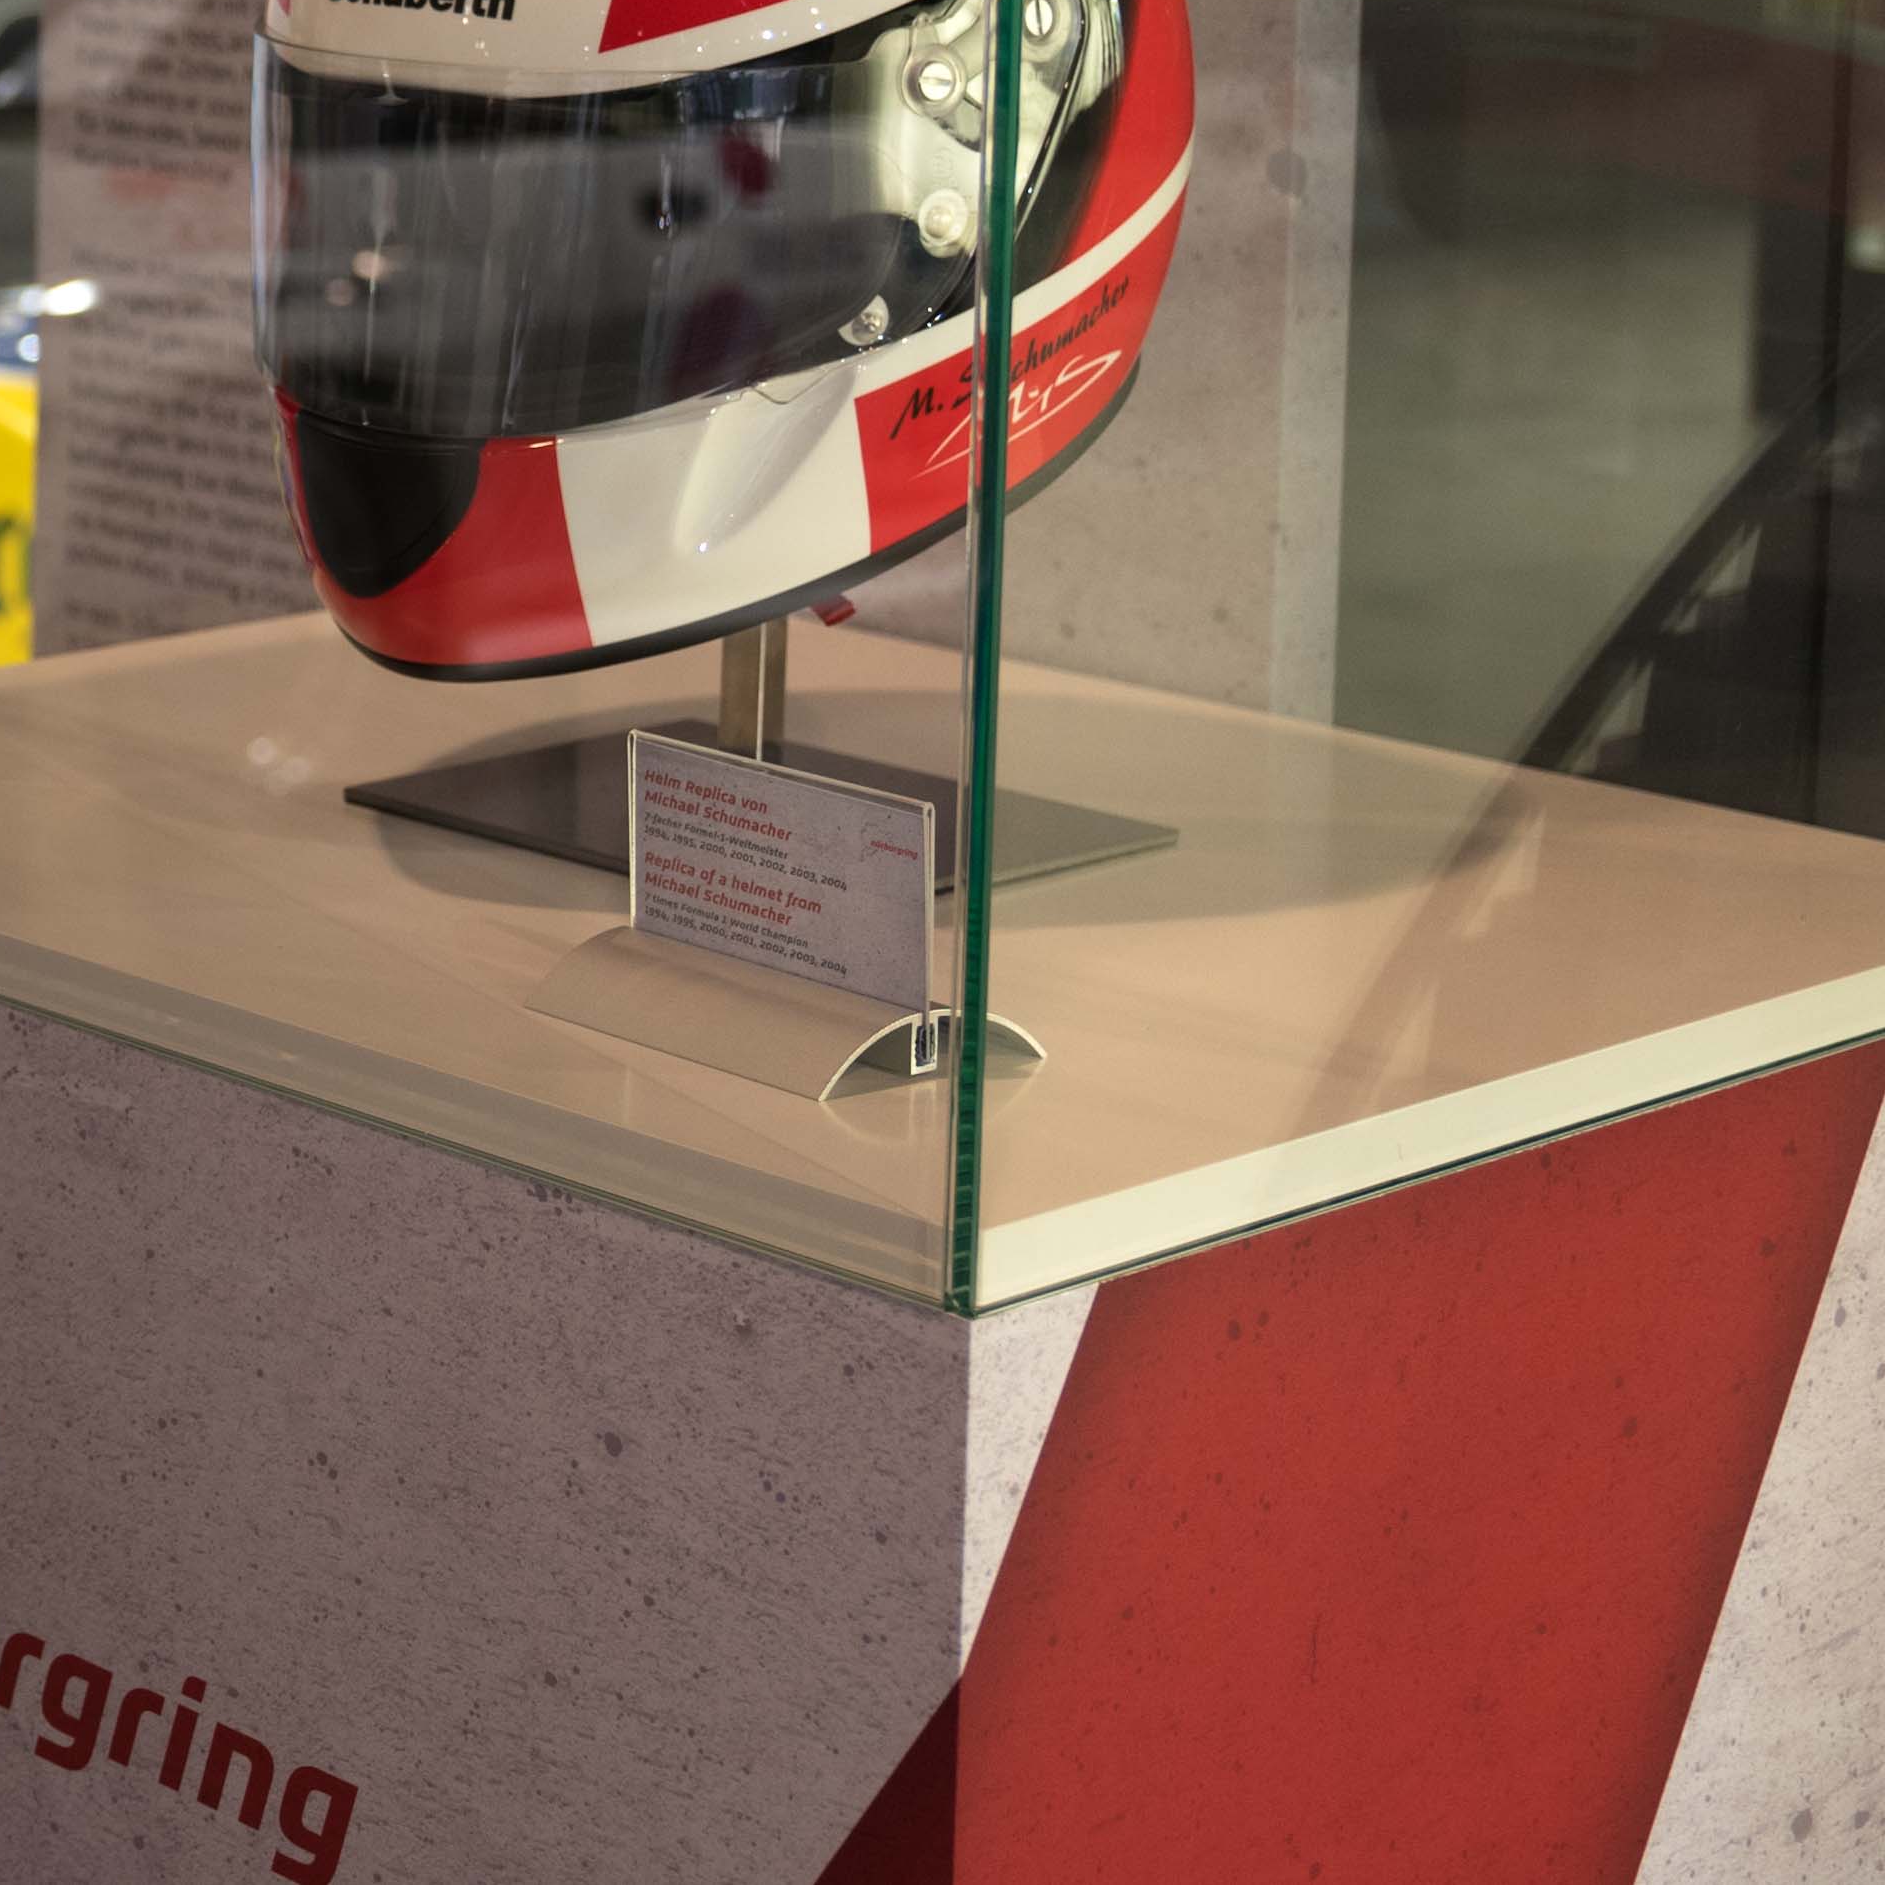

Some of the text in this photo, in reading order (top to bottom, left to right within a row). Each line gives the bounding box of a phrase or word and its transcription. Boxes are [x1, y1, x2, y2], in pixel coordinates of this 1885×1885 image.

[889, 386, 944, 440] M.
[645, 770, 767, 814] Helm Replica von
[645, 790, 792, 841] Michael Schumacher
[645, 825, 669, 842] 1994,
[699, 840, 727, 858] 2000,
[730, 848, 757, 866] 2001,
[759, 857, 787, 874] 2002,
[790, 866, 818, 884] 2003,
[821, 874, 847, 892] 2004
[645, 852, 822, 914] Replica of a helmet from
[645, 873, 792, 926] Michael Schumacher
[645, 892, 651, 902] 7
[653, 895, 679, 908] times
[681, 902, 719, 924] Formula
[730, 916, 758, 934] World
[761, 926, 809, 949] Champion
[645, 906, 669, 924] 1994,
[699, 922, 727, 940] 2000,
[730, 930, 757, 948] 2001,
[759, 939, 787, 957] 2002,
[790, 948, 818, 966] 2003,
[821, 957, 847, 975] 2004
